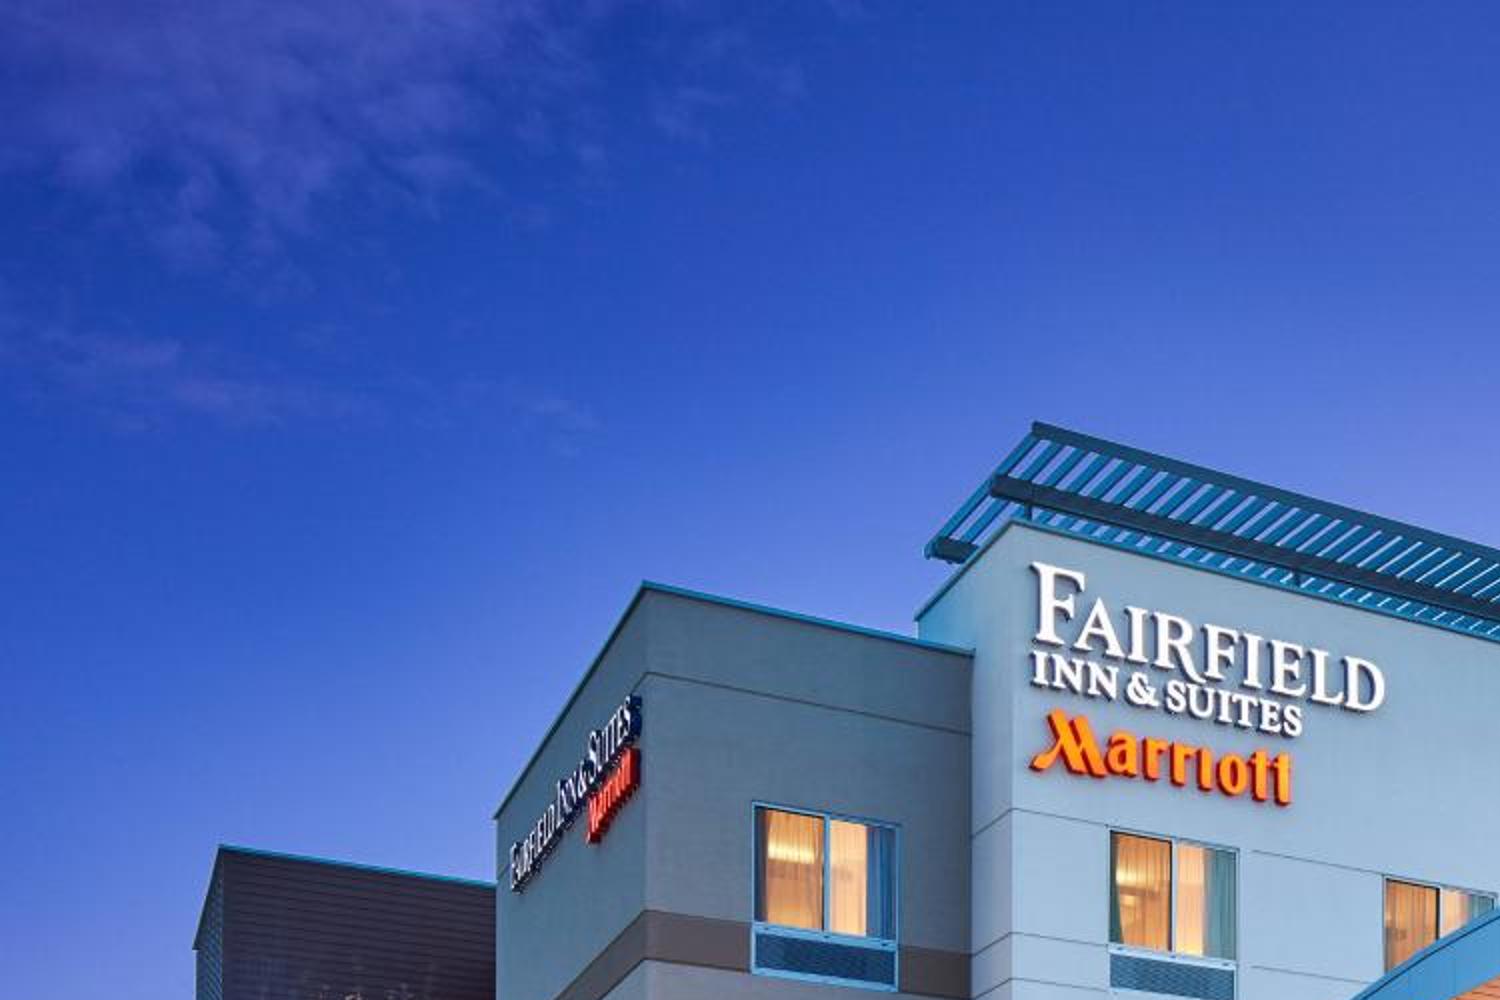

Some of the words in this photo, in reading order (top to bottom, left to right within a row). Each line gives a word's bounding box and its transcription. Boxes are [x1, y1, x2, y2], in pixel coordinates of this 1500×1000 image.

[1030, 561, 1386, 712] FAIRFIELD
[1031, 650, 1119, 702] INN
[1126, 671, 1159, 709] &
[1164, 679, 1302, 738] SUITES
[1030, 707, 1292, 807] Marriott
